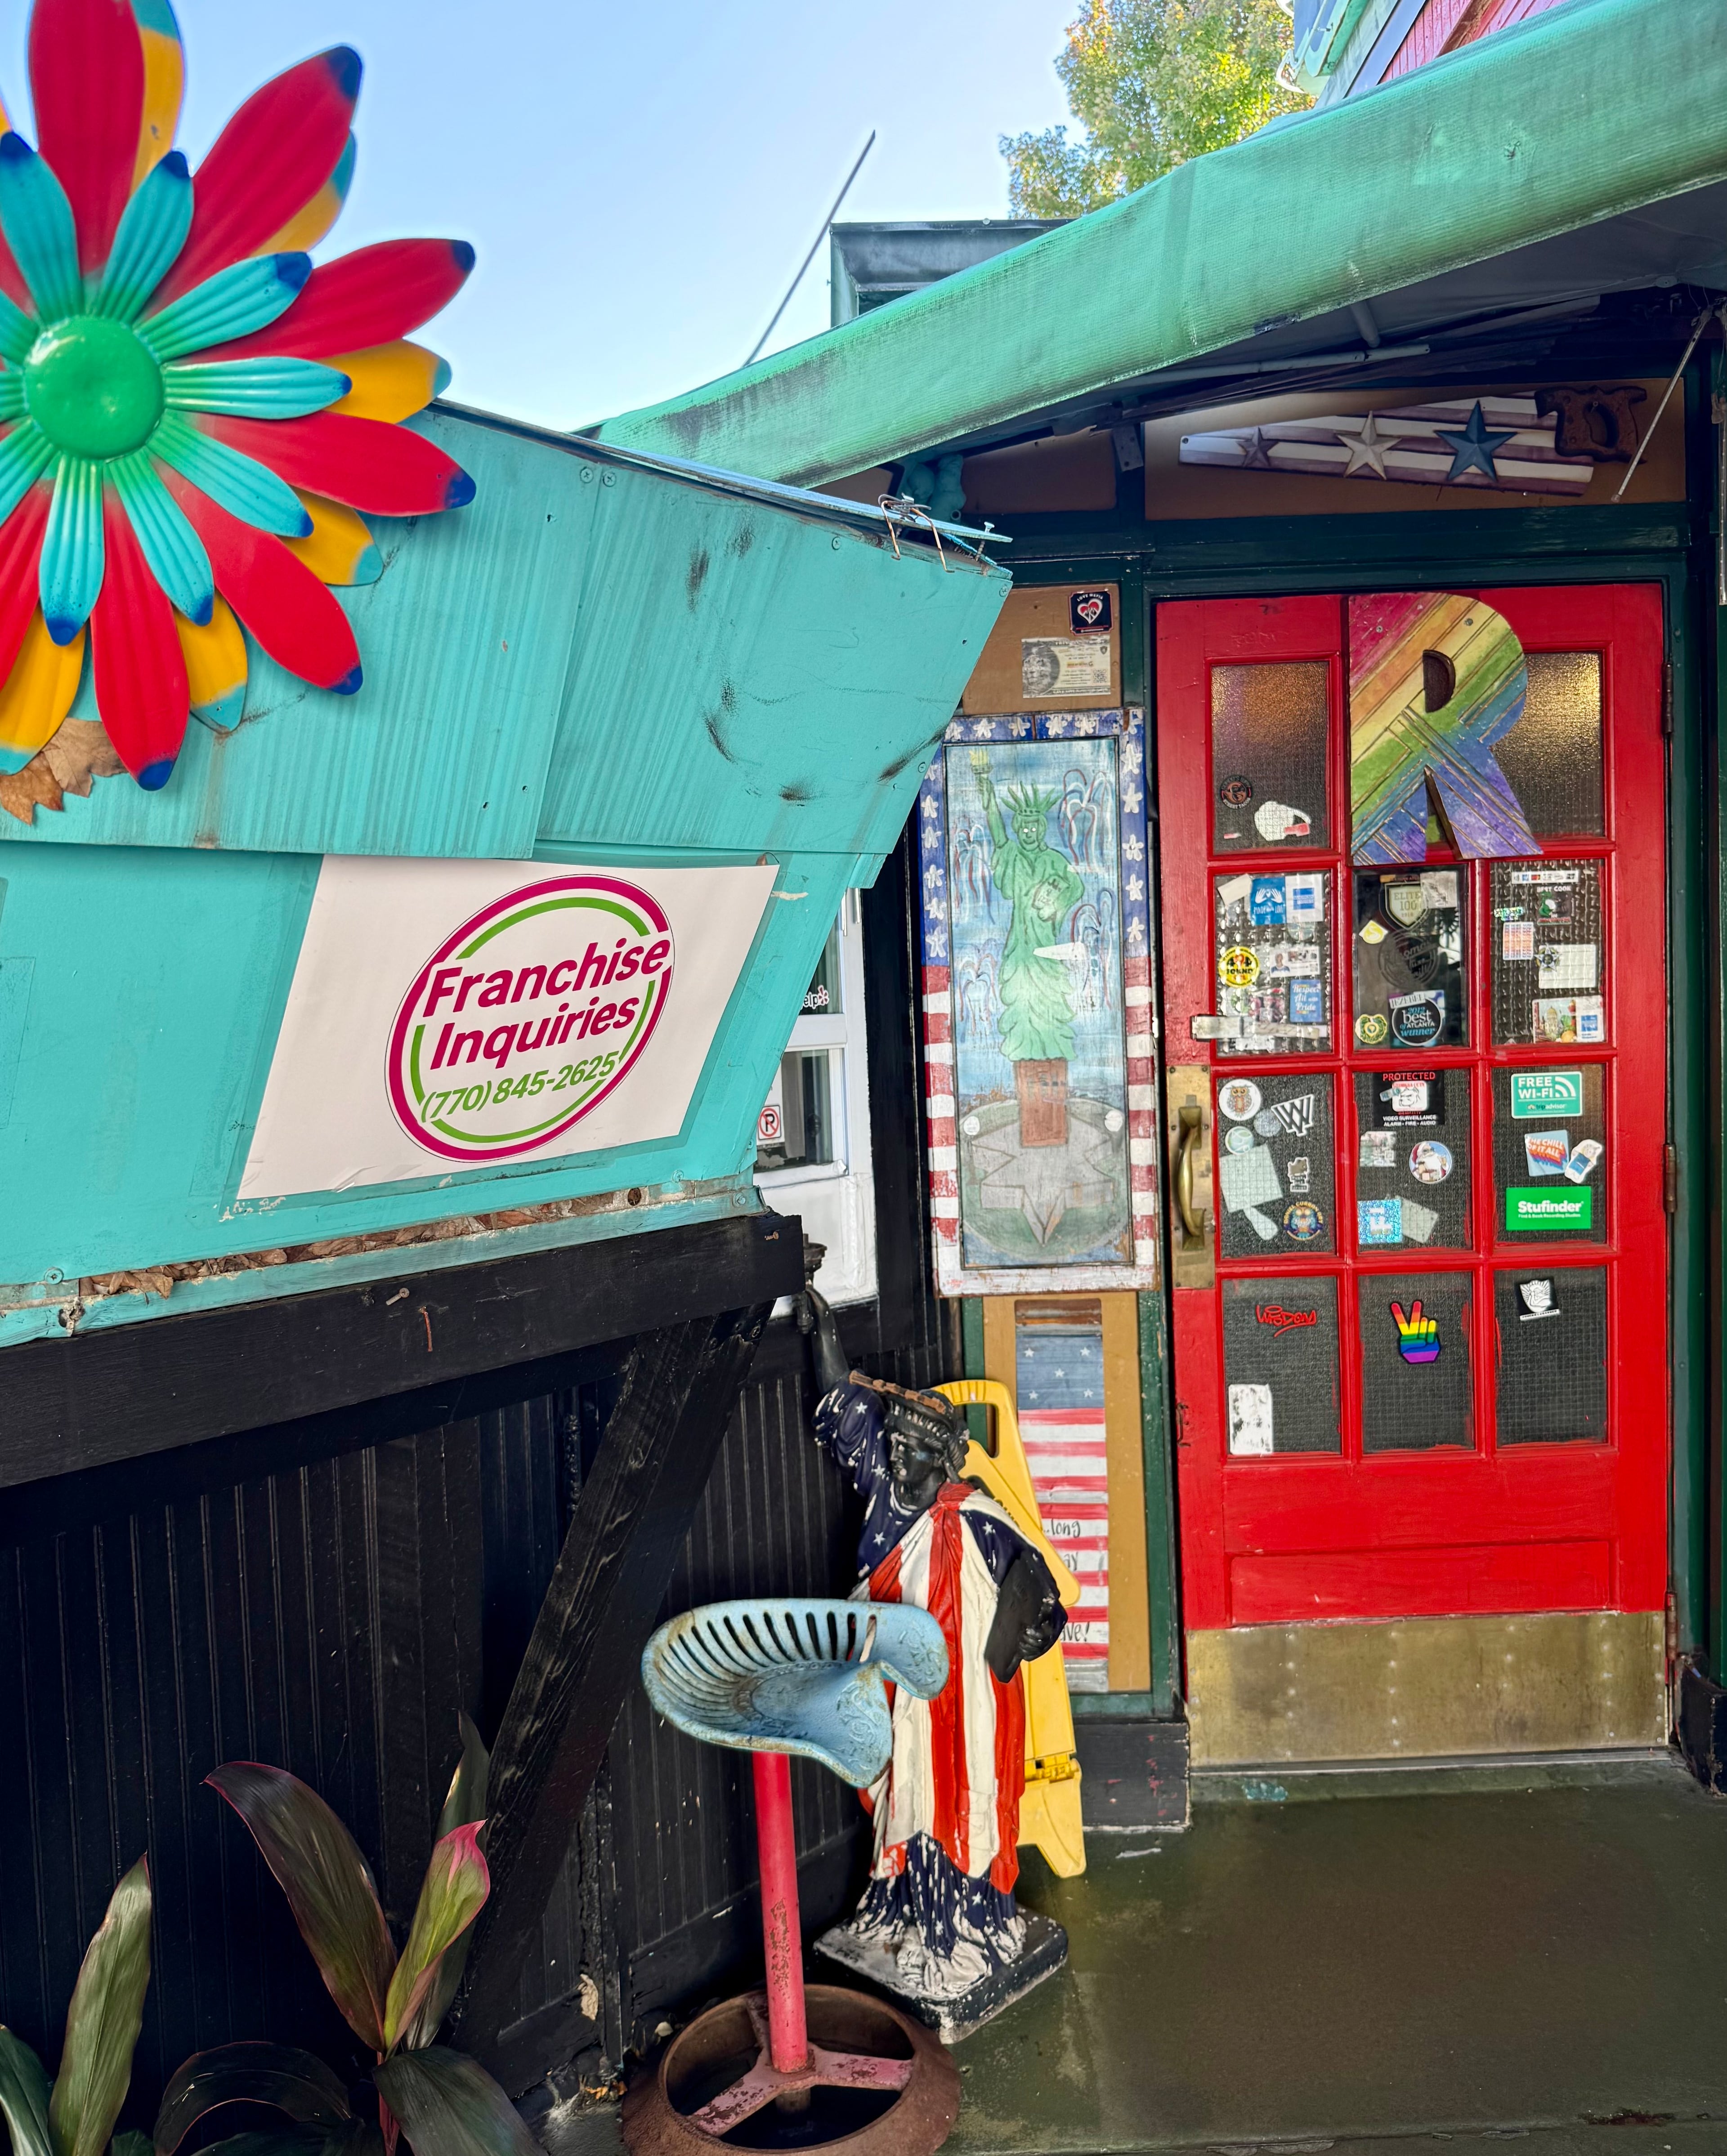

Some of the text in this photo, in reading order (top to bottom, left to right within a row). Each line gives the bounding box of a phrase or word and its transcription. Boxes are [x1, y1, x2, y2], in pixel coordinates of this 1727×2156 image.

[1394, 891, 1421, 900] ELITE
[1400, 900, 1417, 911] 100
[423, 938, 671, 1018] Franchise
[801, 993, 819, 1008] elp
[1294, 993, 1306, 1003] All
[1295, 1002, 1316, 1011] Pride
[1402, 1009, 1432, 1024] best
[430, 996, 640, 1070] Inquiries
[1400, 1027, 1435, 1036] winner
[1383, 1072, 1435, 1081] PROTECTED
[1518, 1076, 1552, 1088] FREE
[421, 1051, 619, 1123] (770) 845-2625
[1518, 1088, 1553, 1099] WI-FI
[1542, 1139, 1564, 1150] CHILL
[1546, 1147, 1560, 1158] ALL
[1518, 1200, 1582, 1213] Stufinder
[1064, 1552, 1078, 1571] ay
